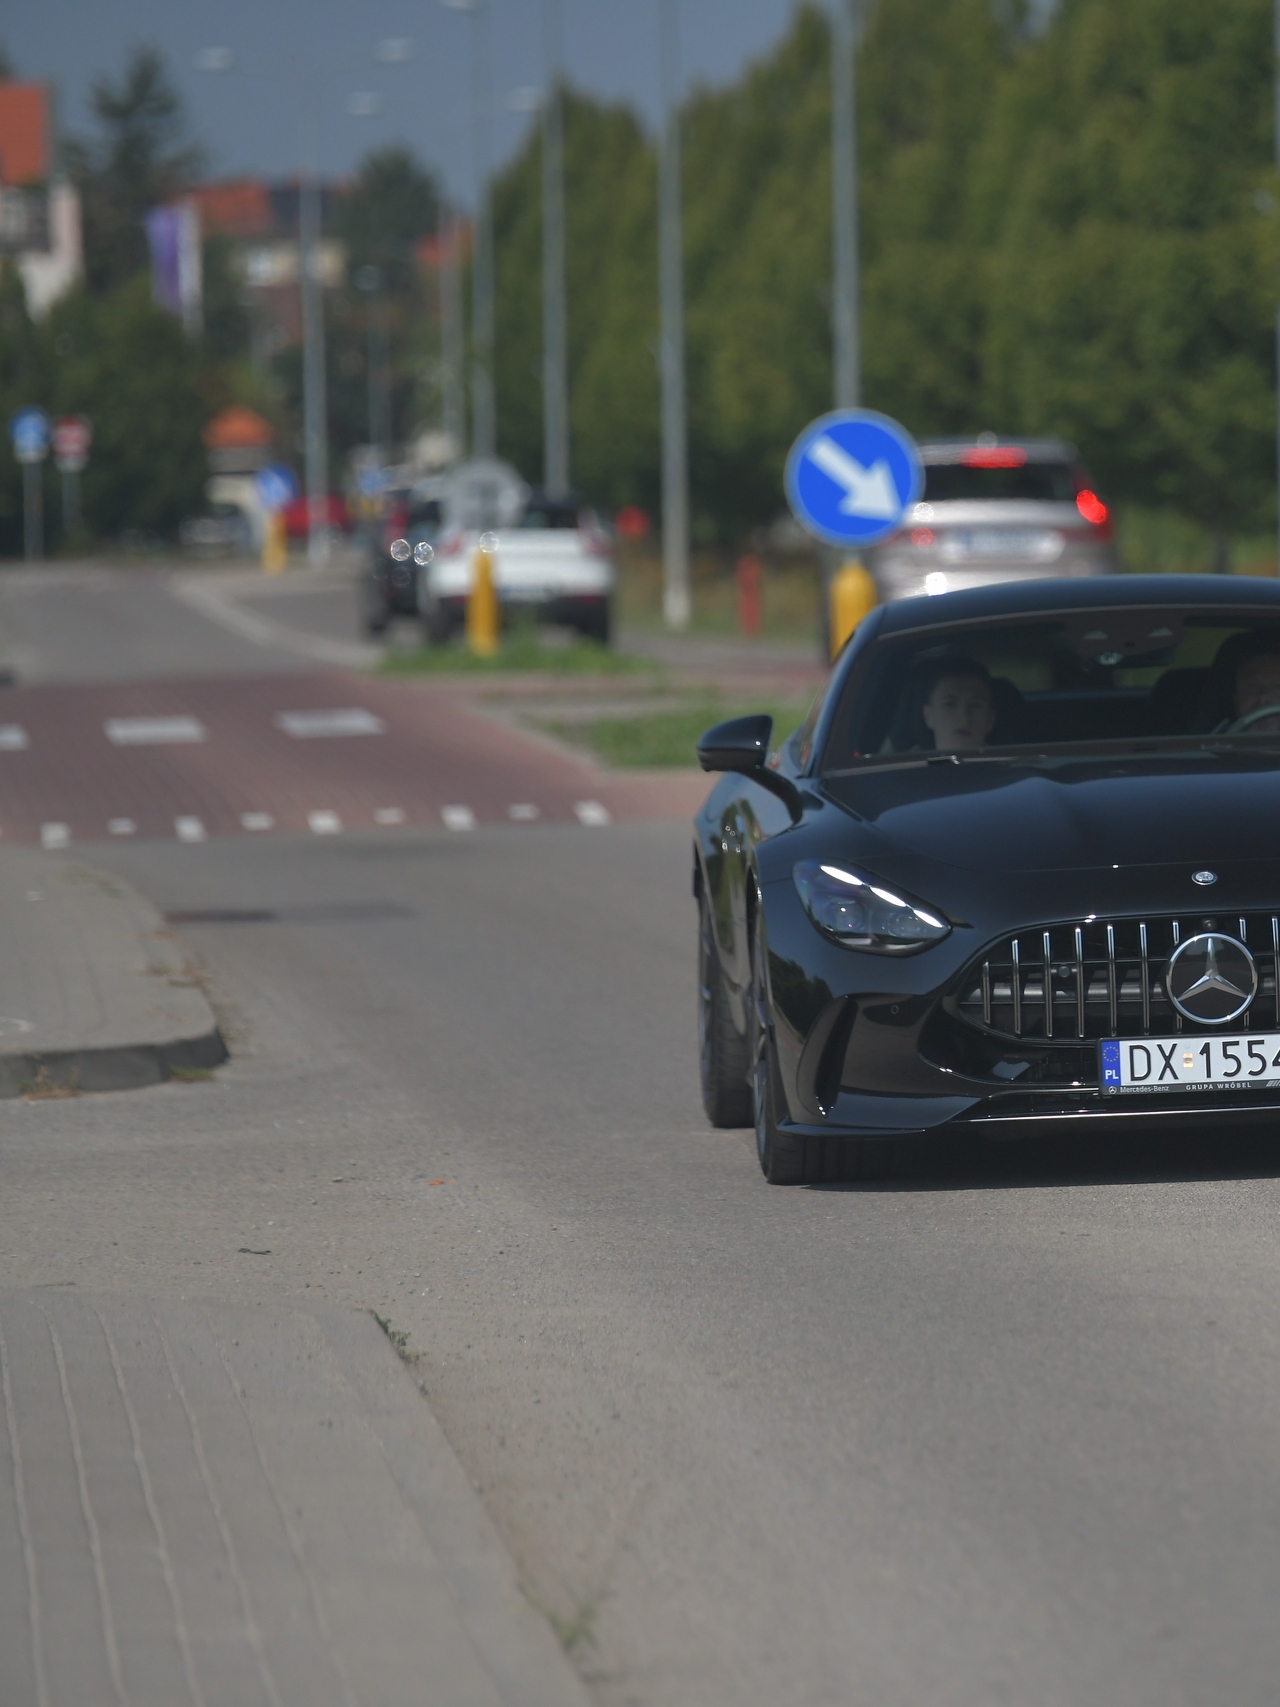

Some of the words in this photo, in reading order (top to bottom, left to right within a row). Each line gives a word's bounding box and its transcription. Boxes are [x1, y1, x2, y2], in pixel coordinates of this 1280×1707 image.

[1129, 1043, 1179, 1081] DX
[1105, 1070, 1119, 1080] PL
[1120, 1085, 1169, 1093] Mercedes-Benz
[1186, 1082, 1214, 1091] GRUPA
[1217, 1081, 1252, 1089] WRÓBEL
